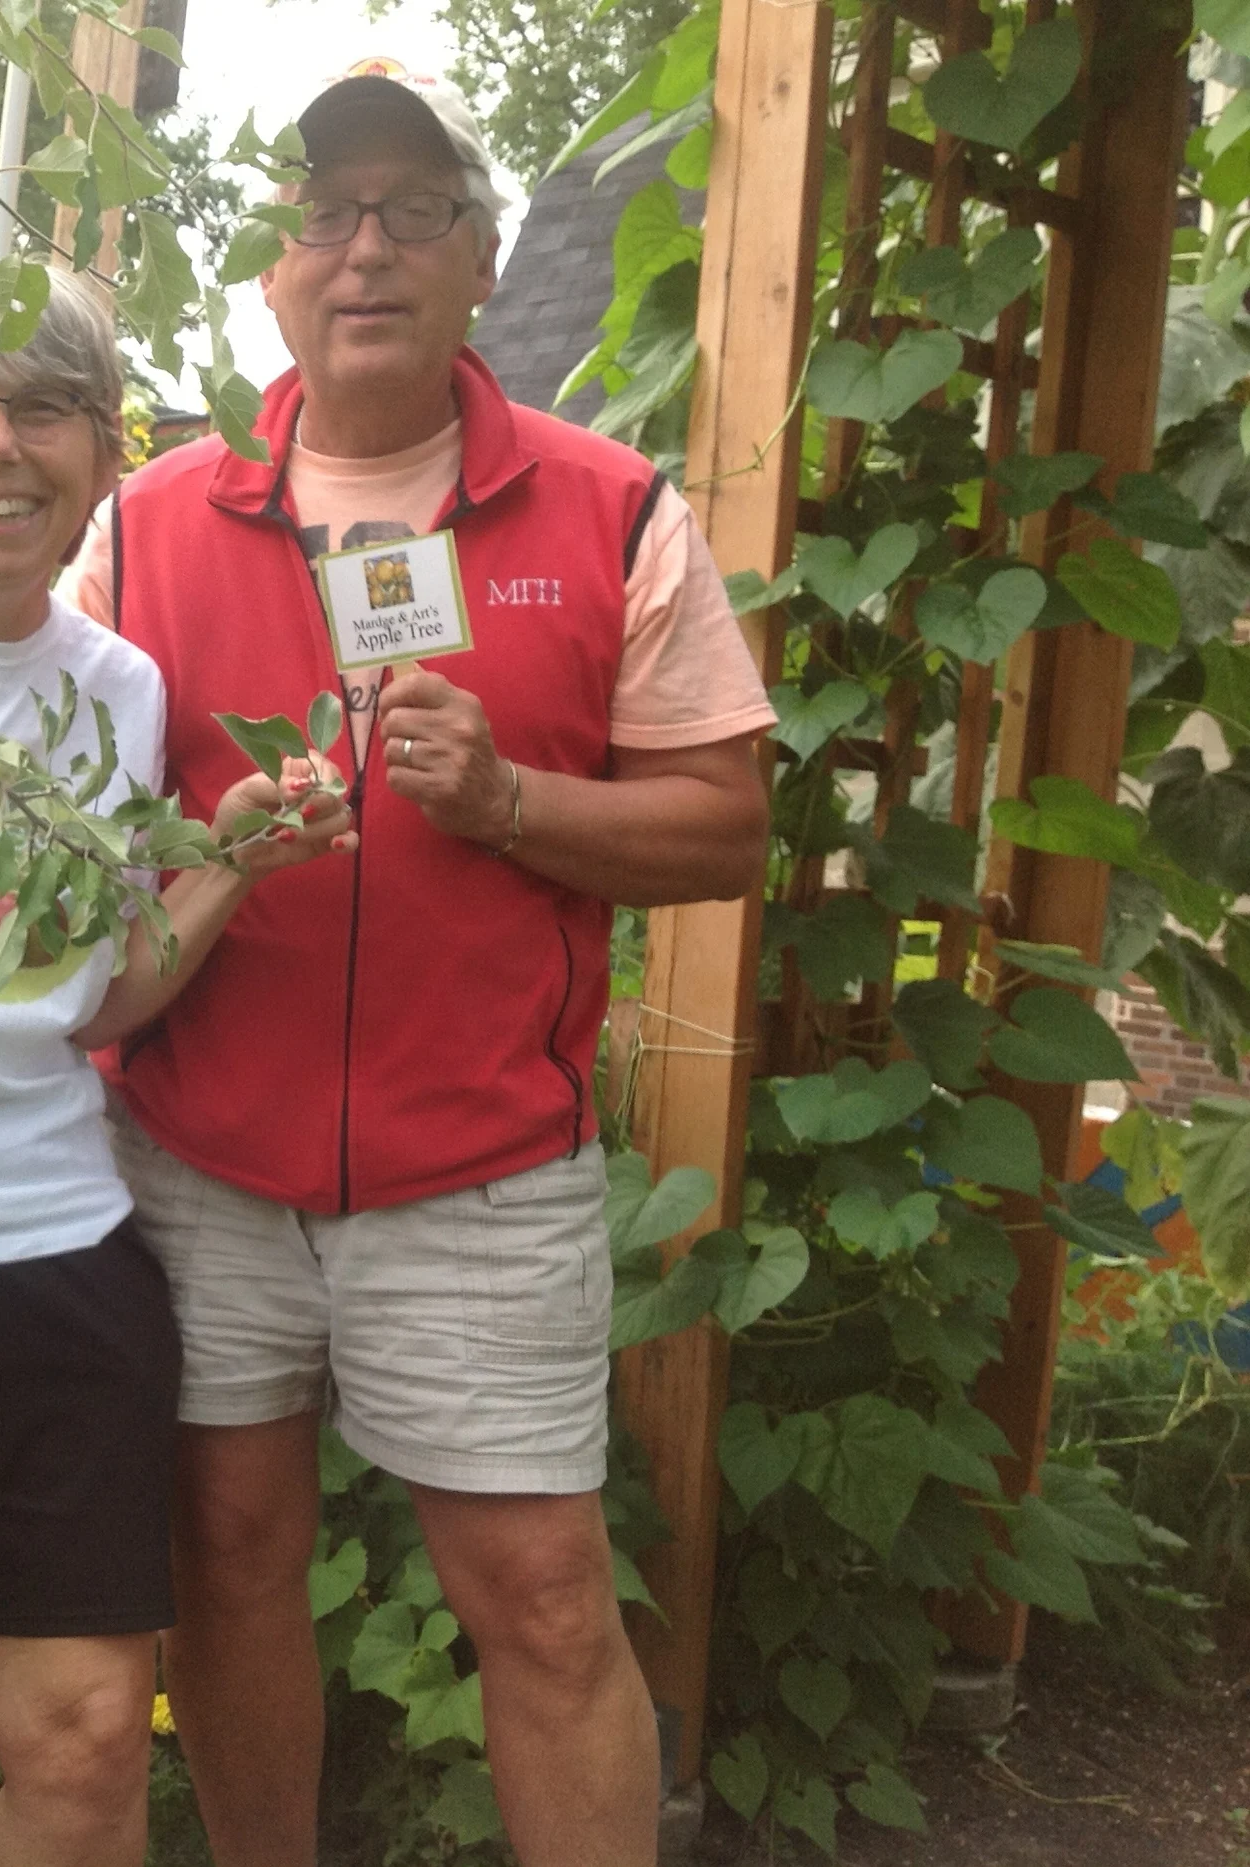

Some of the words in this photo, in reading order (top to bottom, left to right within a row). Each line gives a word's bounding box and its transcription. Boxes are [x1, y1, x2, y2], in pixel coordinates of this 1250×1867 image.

[352, 614, 396, 632] Mardge
[398, 611, 408, 624] &
[411, 605, 440, 621] Art's
[356, 627, 403, 652] Apple
[405, 622, 444, 640] Tree
